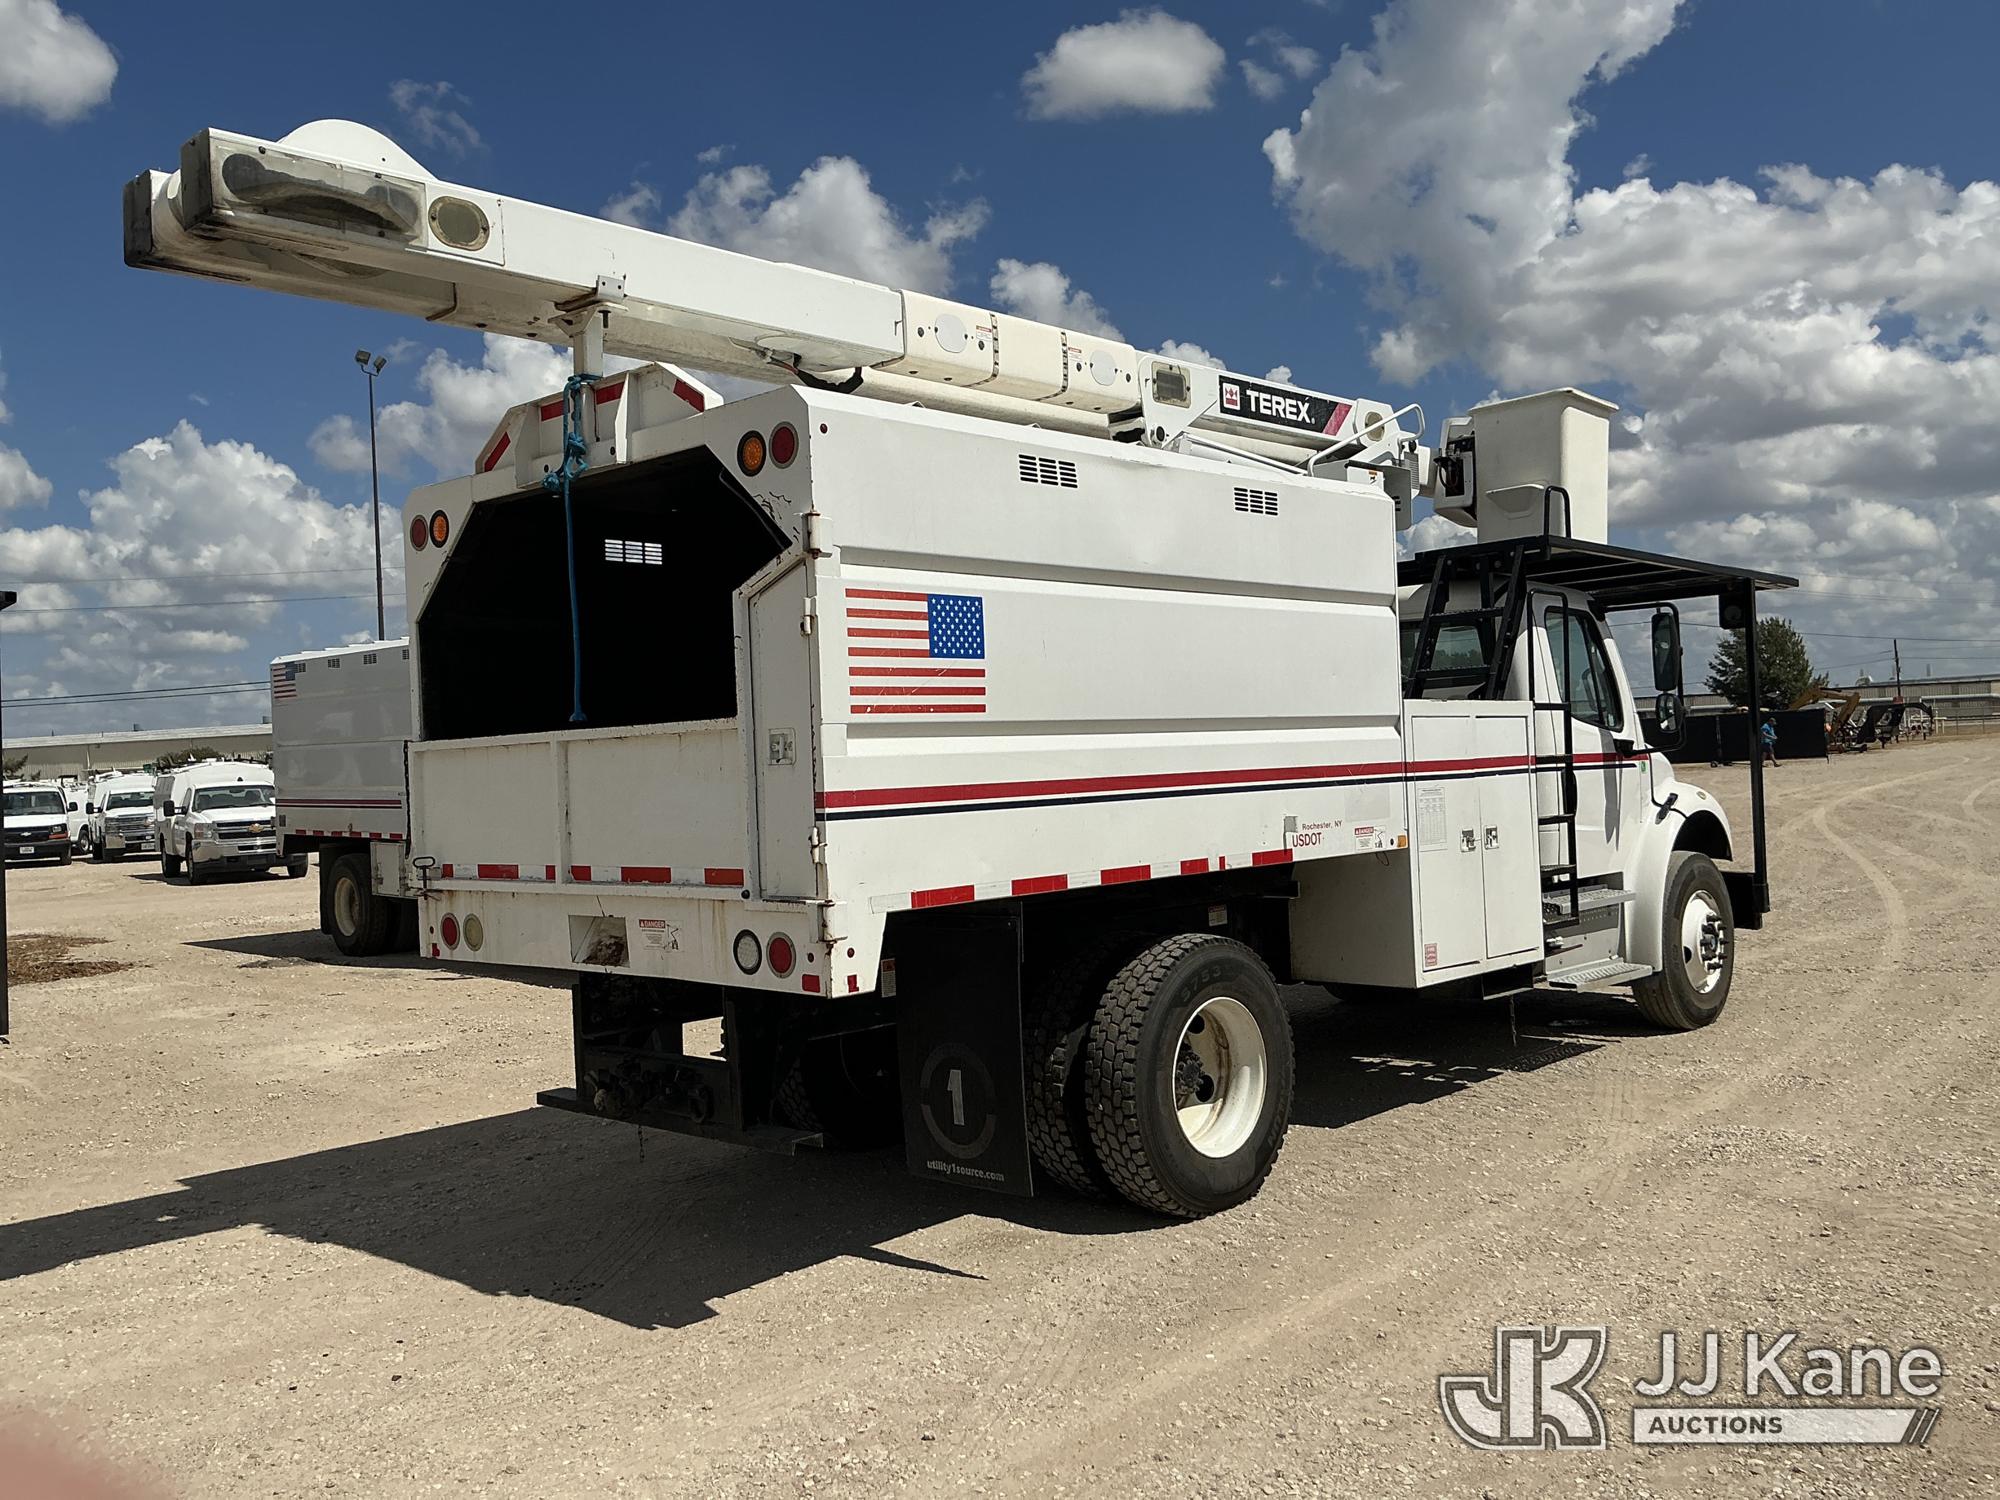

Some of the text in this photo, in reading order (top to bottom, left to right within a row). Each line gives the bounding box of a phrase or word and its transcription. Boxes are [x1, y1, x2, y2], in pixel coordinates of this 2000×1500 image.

[1246, 389, 1311, 424] TEREX
[1292, 833, 1321, 847] USDOT
[947, 1069, 965, 1126] 1
[927, 1160, 1004, 1181] utility1source.com
